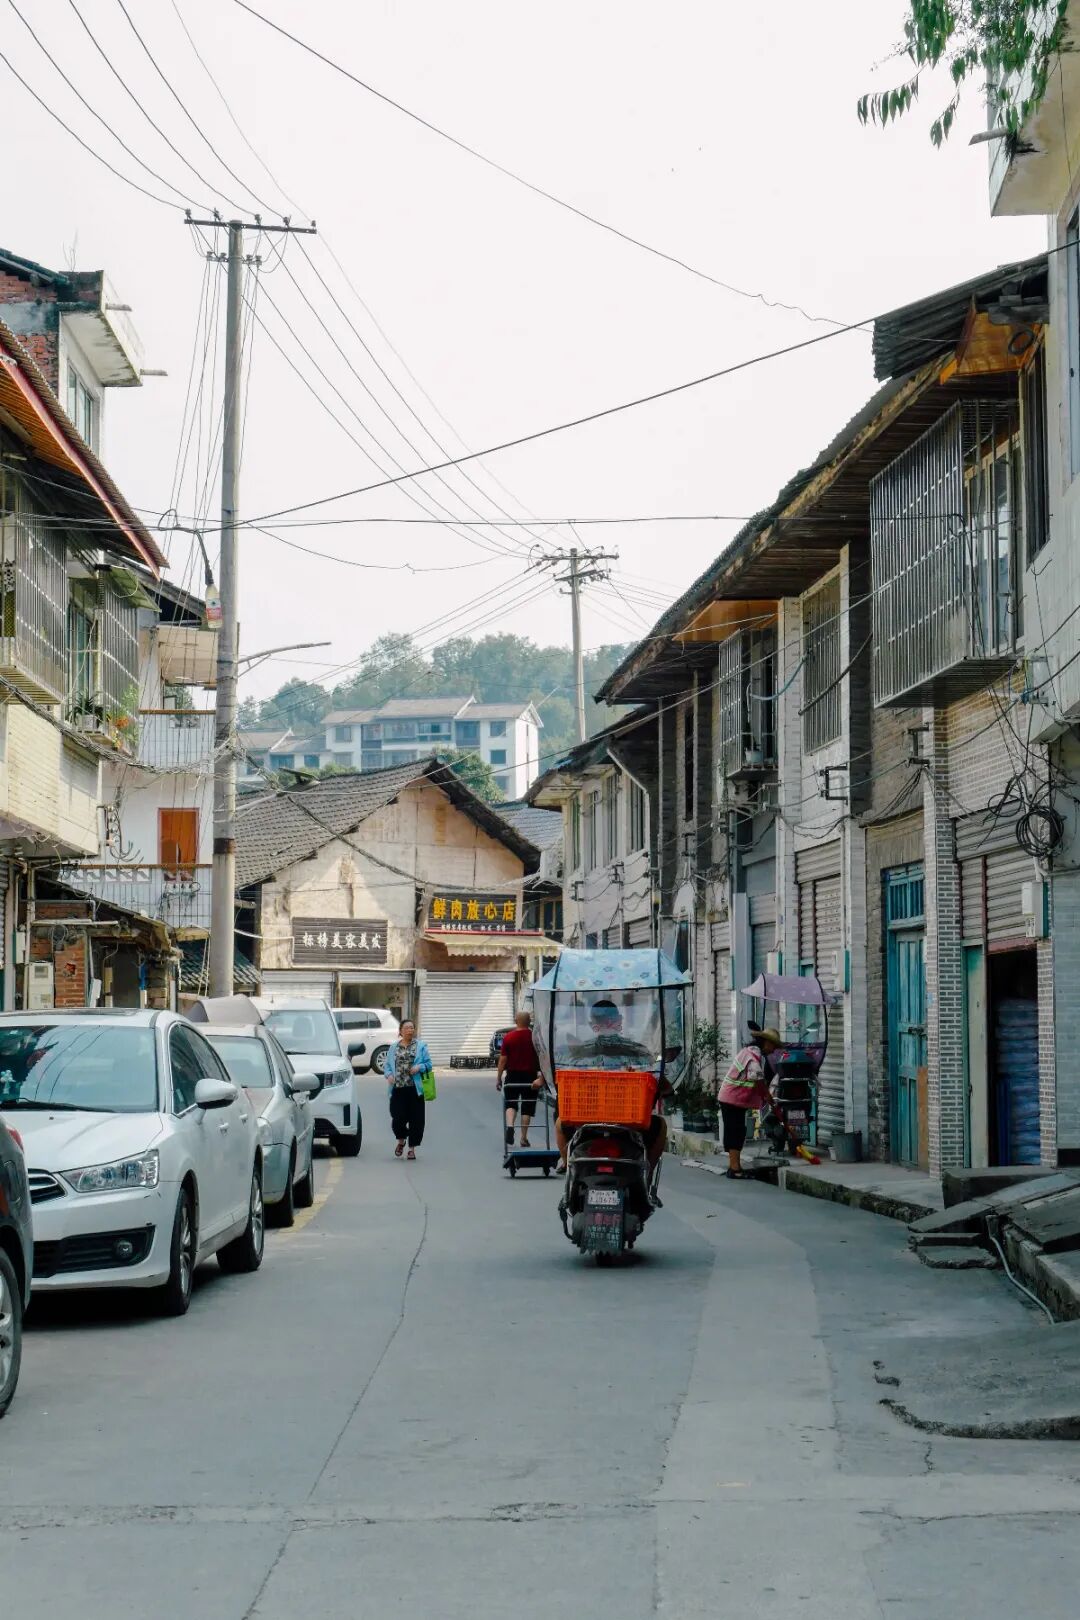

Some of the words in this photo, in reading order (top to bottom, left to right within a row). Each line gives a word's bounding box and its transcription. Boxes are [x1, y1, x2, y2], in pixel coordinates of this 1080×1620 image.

[432, 897, 515, 921] 鲜肉放心店
